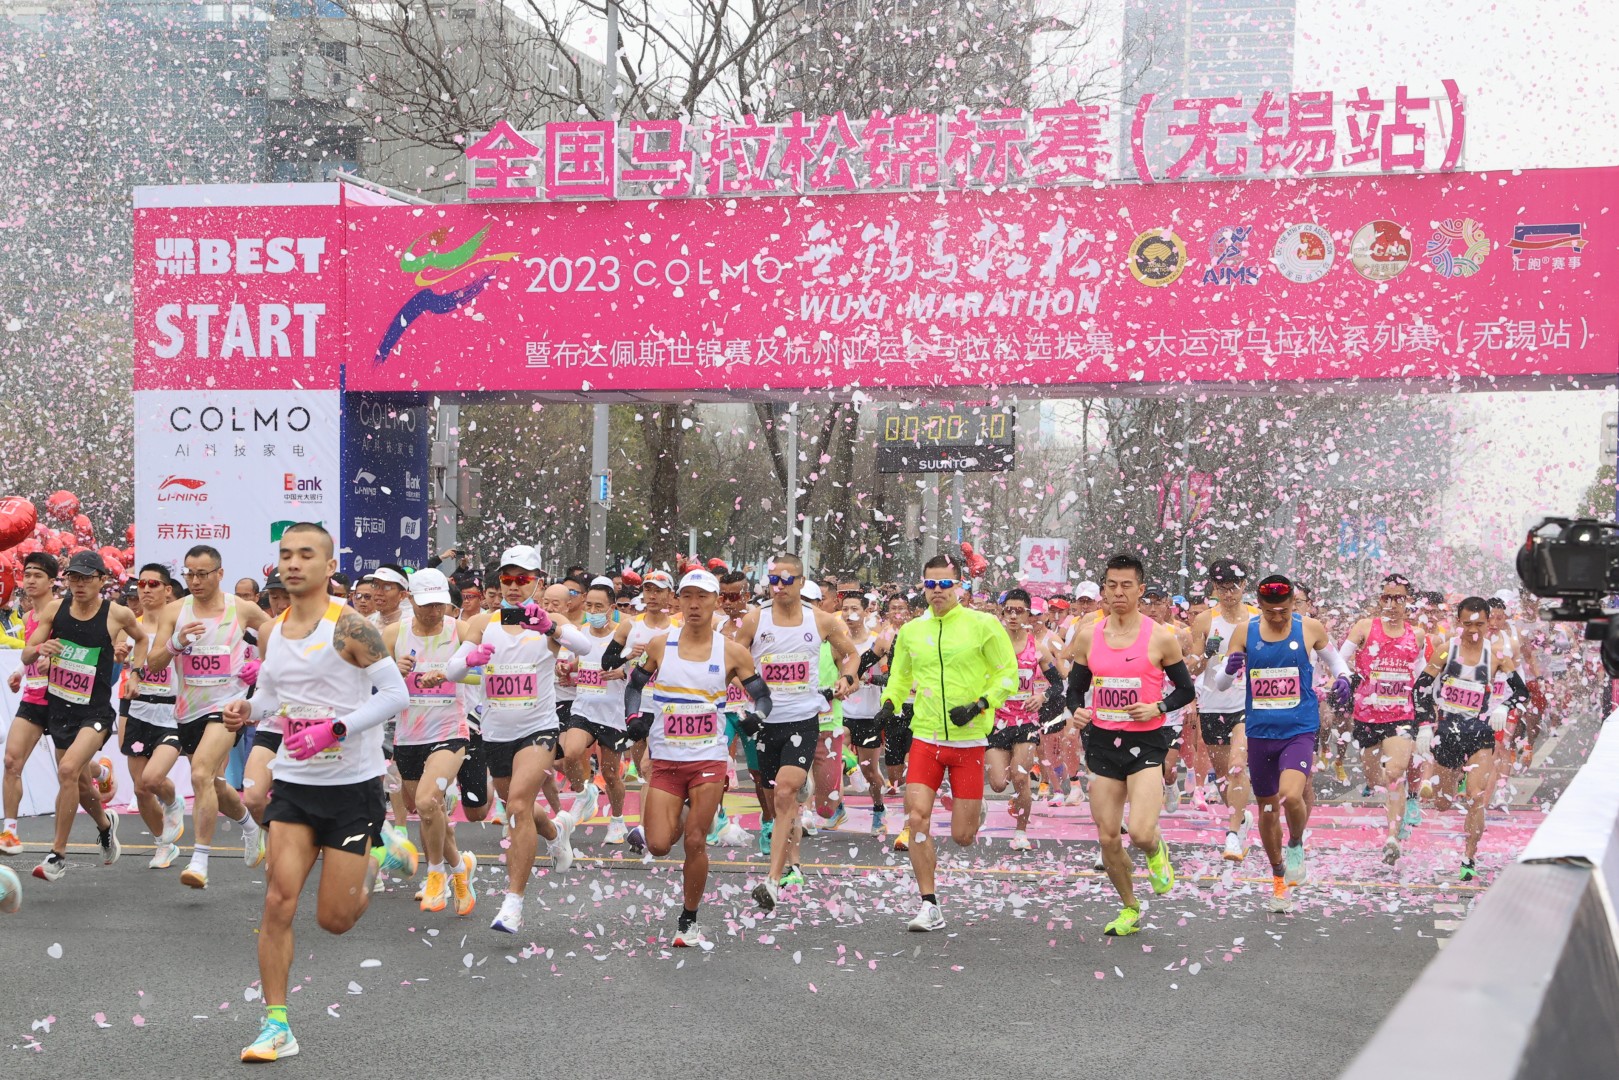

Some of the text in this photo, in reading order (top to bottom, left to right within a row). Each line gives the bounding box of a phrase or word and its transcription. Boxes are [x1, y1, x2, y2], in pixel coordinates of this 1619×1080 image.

[199, 236, 326, 274] BEST
[525, 256, 783, 293] 2023 COLMO
[1202, 266, 1260, 286] AIMS
[800, 289, 1101, 321] WUXI MARATHON
[155, 303, 326, 359] START
[169, 406, 311, 432] COLMO
[918, 460, 968, 470] SUUNTO
[158, 493, 208, 501] LI-NING
[157, 522, 231, 540] 京东运动
[191, 656, 221, 671] 605
[765, 663, 806, 681] 23219
[51, 667, 90, 692] 11294
[489, 676, 533, 696] 12014
[1098, 688, 1138, 708] 10050
[667, 714, 714, 735] 21875
